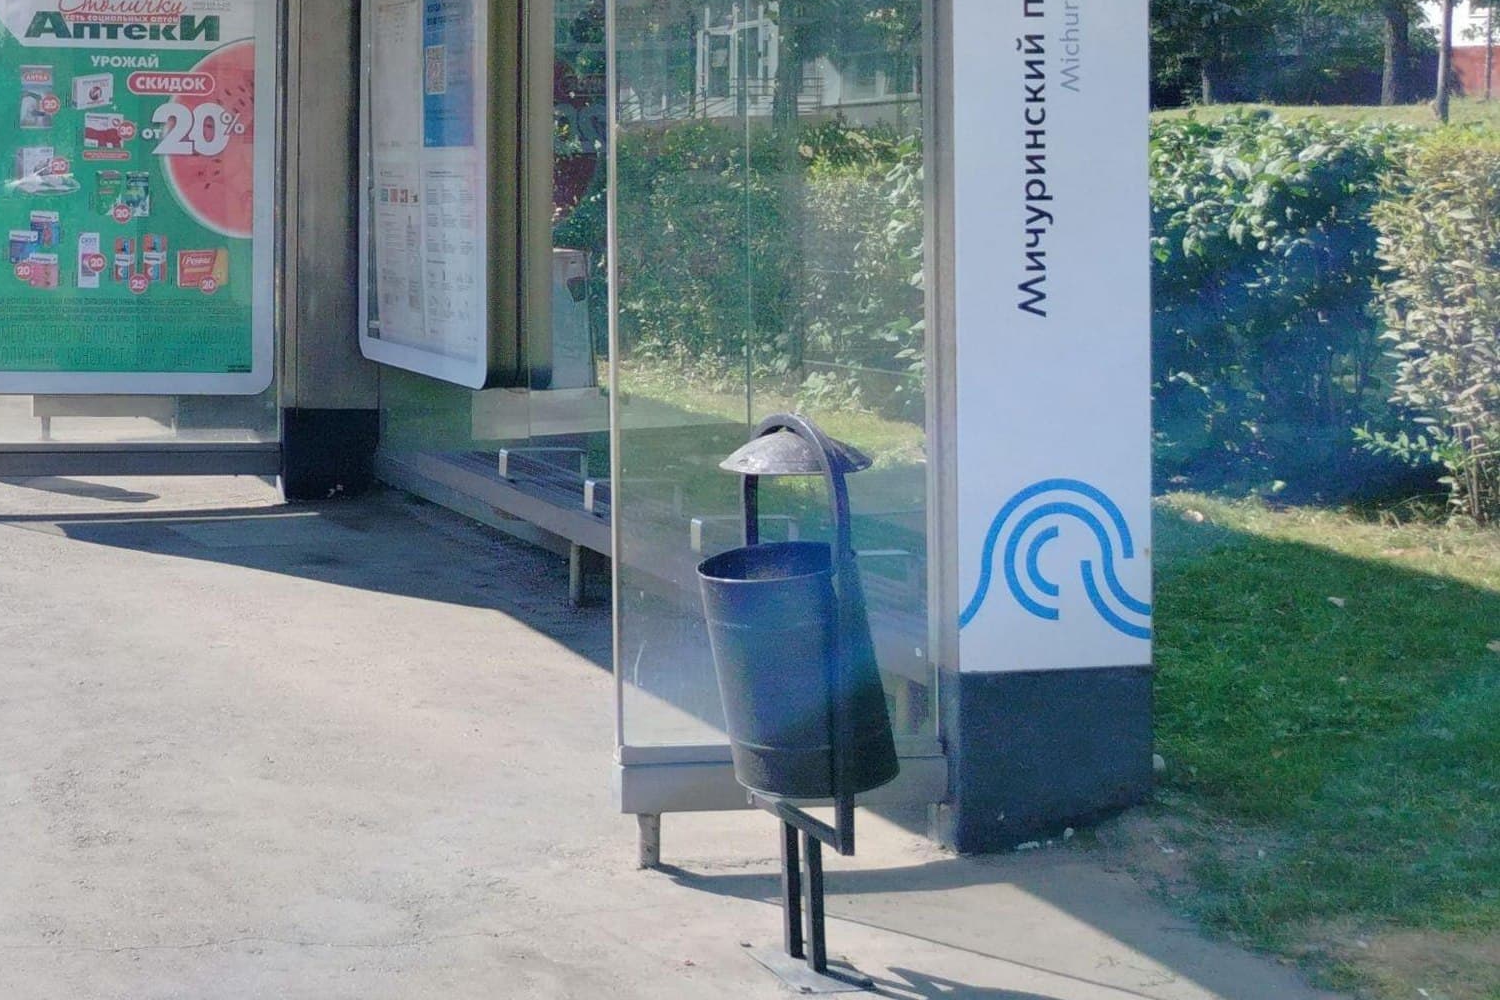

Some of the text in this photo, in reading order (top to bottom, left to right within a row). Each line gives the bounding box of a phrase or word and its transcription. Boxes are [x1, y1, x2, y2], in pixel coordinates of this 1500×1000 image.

[87, 14, 148, 24] социальных
[91, 54, 159, 68] УРОЖАЙ
[135, 76, 206, 92] СКИДОК
[141, 128, 162, 140] от
[1015, 33, 1053, 318] Мичуринский
